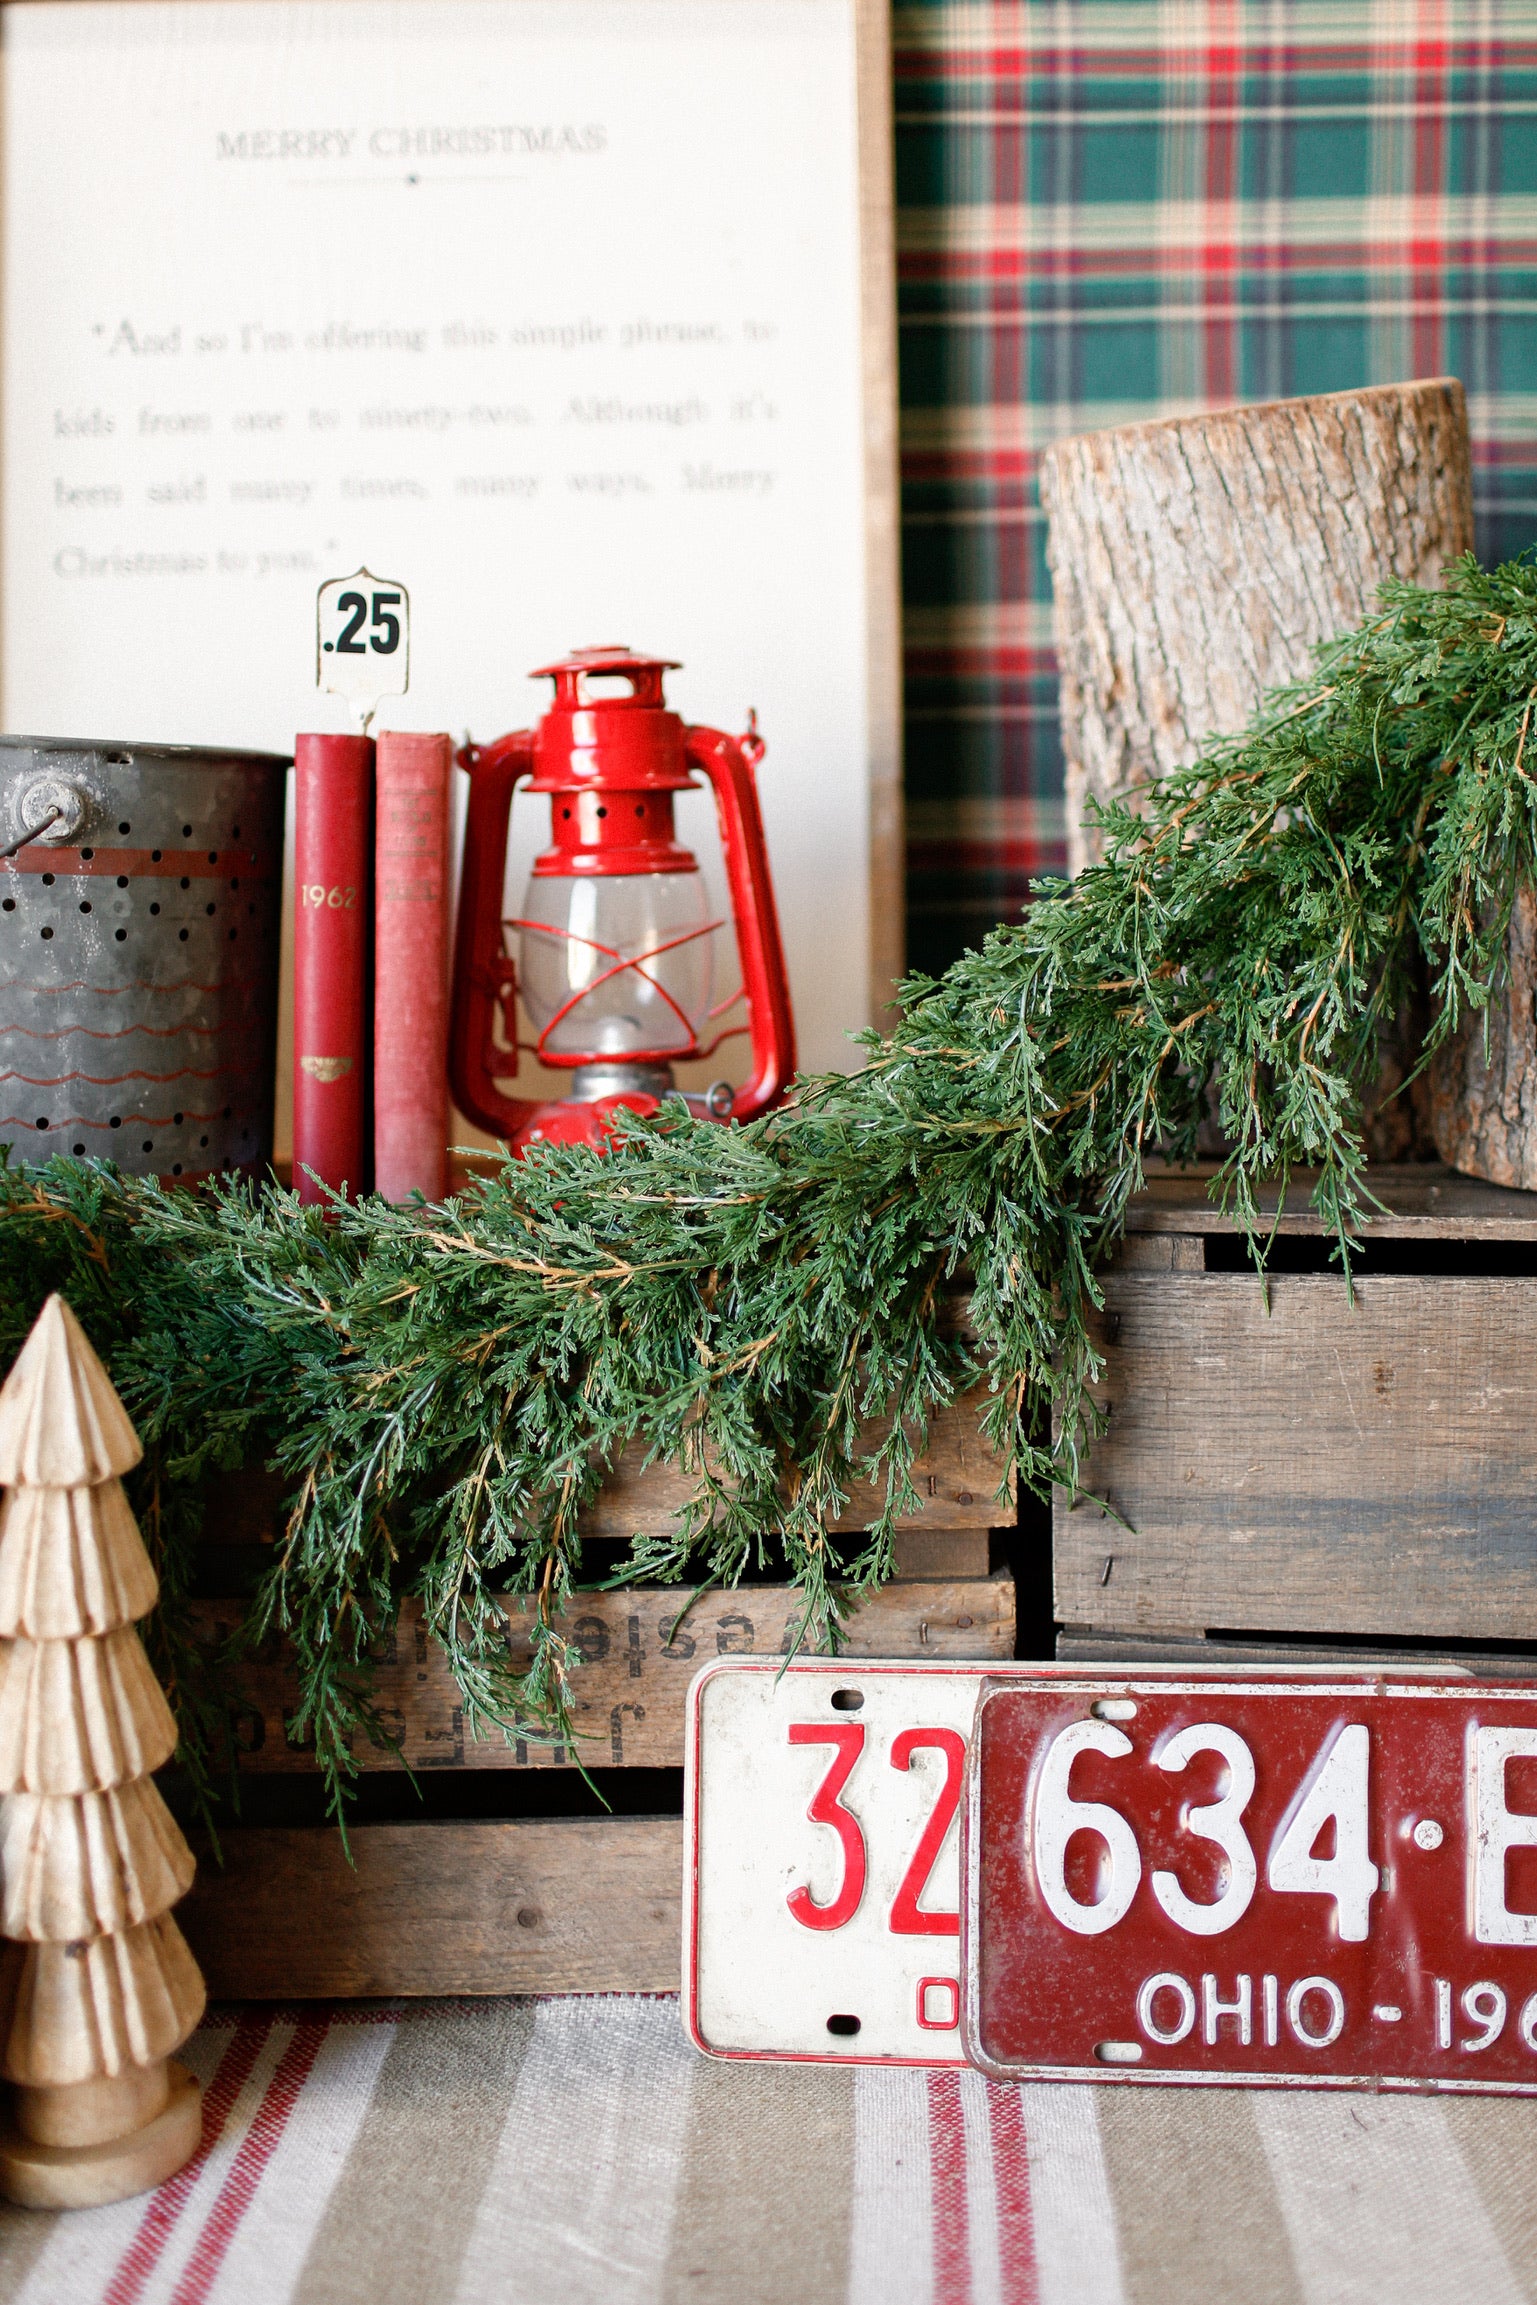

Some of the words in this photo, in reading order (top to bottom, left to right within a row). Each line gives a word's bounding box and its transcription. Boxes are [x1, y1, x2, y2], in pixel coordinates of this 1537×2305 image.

[216, 129, 356, 161] MERRY
[368, 125, 608, 158] CHRISTMAS
[323, 591, 401, 655] .25
[302, 884, 357, 909] 1962
[1139, 1972, 1346, 2048] OHIO
